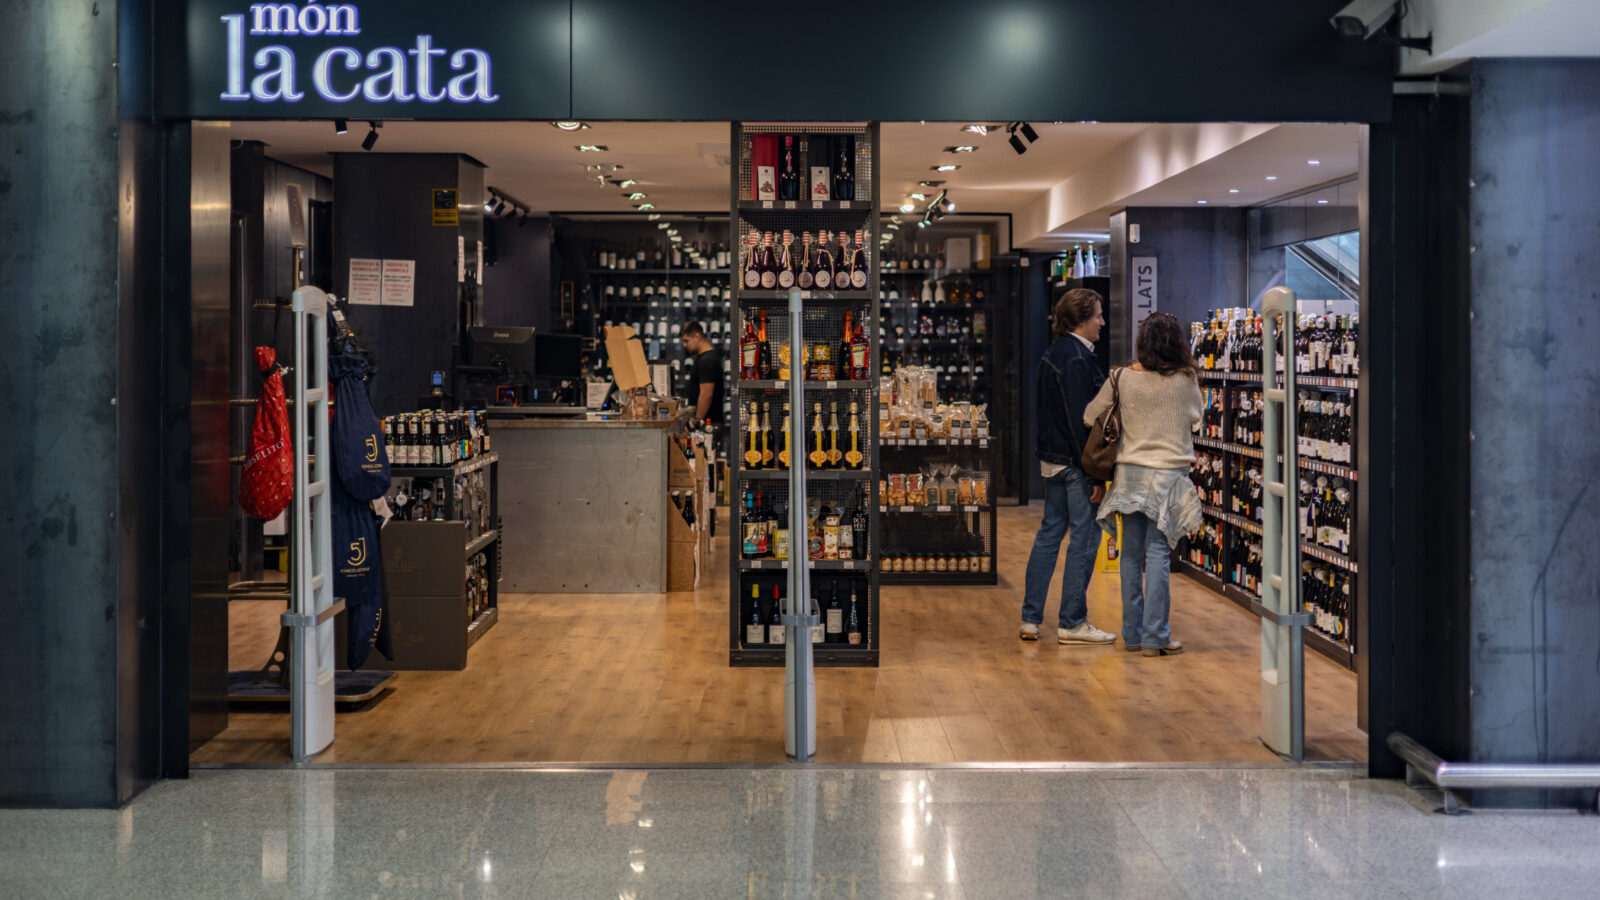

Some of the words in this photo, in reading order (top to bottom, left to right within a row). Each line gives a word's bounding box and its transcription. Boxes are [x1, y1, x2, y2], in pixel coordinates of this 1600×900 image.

[249, 0, 361, 36] món
[219, 13, 304, 103] la
[312, 34, 500, 103] cata
